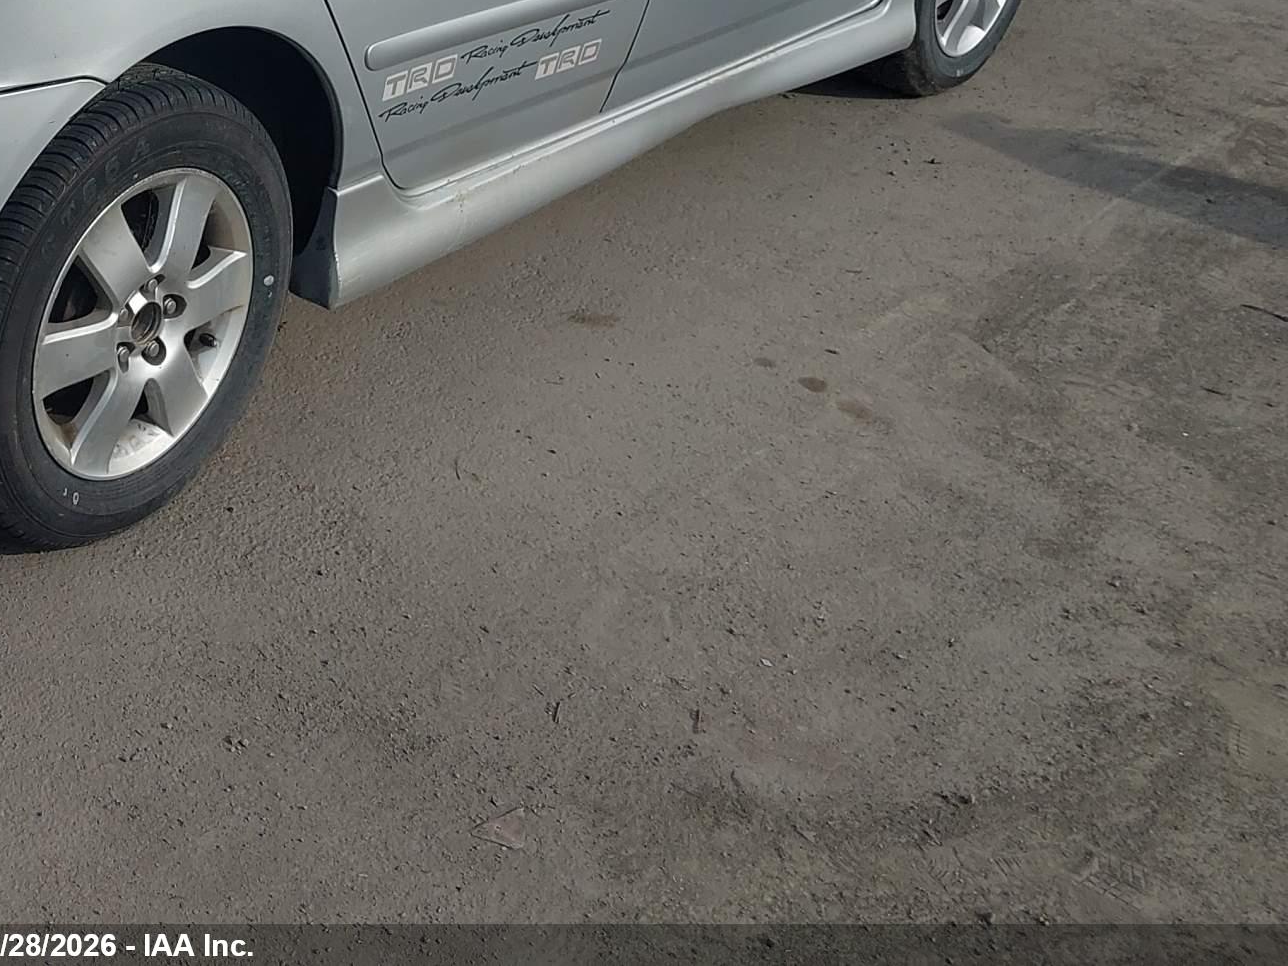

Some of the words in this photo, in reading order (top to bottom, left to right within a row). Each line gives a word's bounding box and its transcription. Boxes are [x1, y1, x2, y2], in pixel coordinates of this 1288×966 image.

[378, 95, 432, 122] Racing
[534, 38, 603, 81] TRD
[382, 54, 458, 101] TRD
[461, 39, 510, 65] Racing
